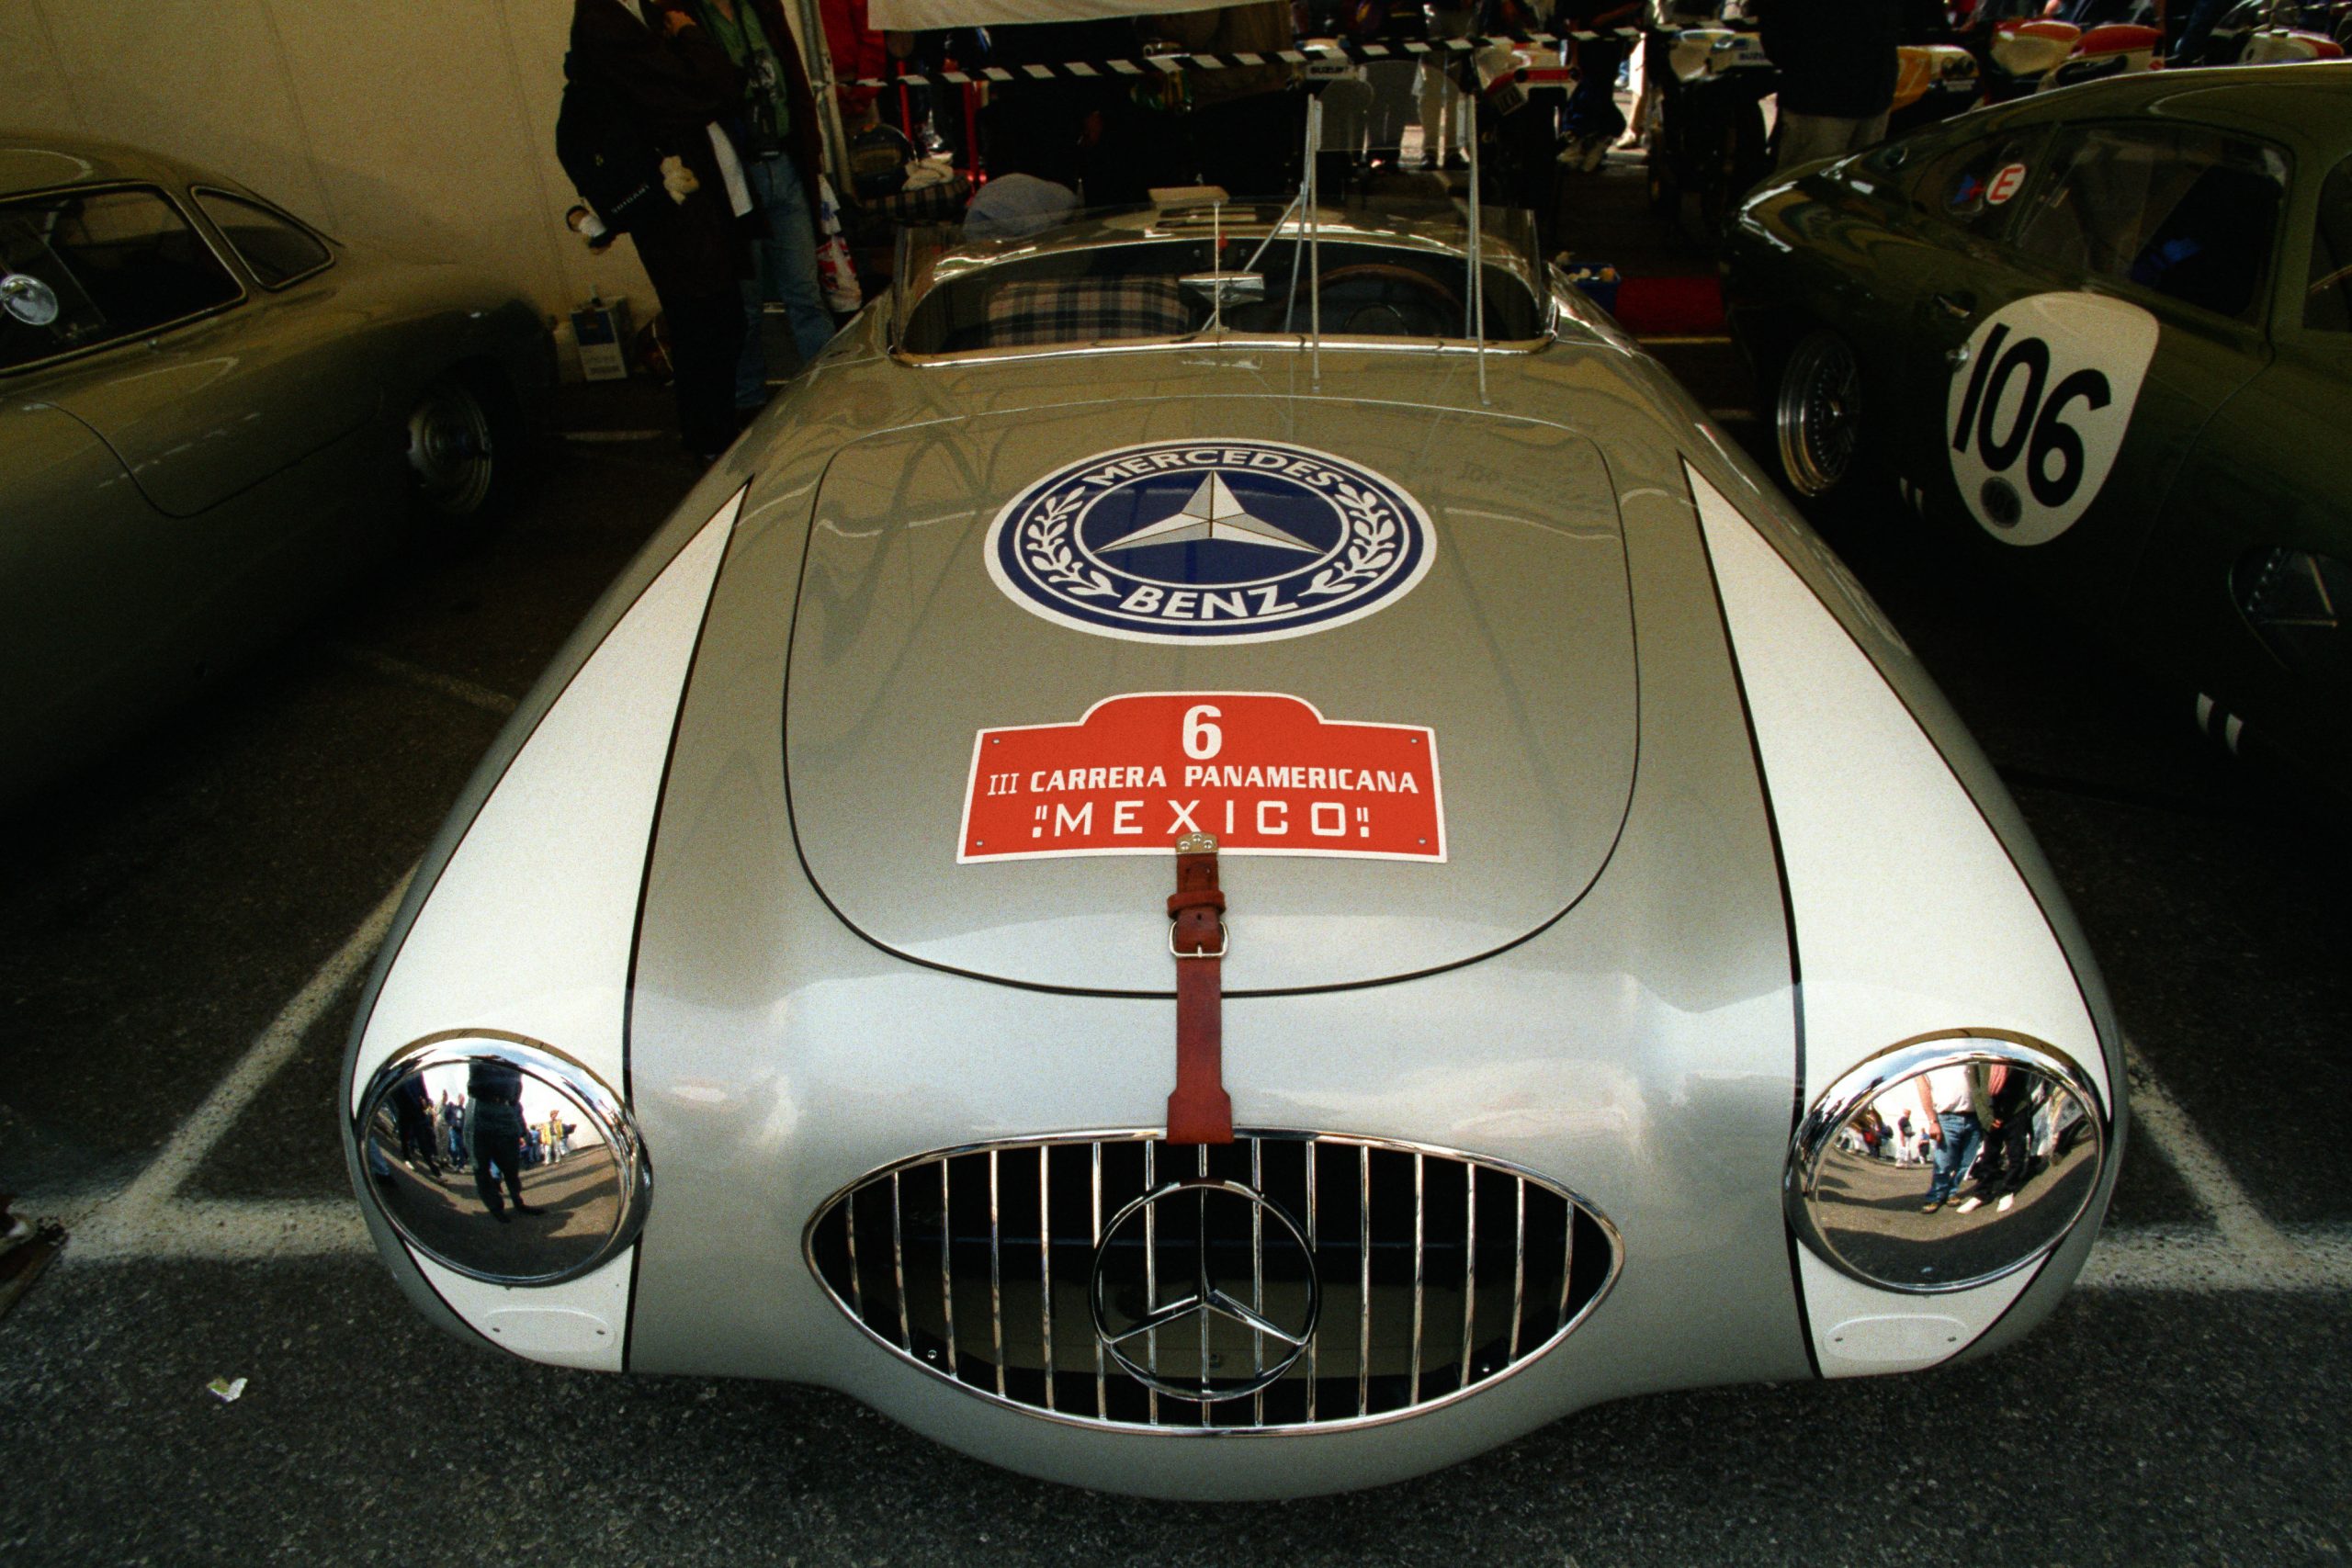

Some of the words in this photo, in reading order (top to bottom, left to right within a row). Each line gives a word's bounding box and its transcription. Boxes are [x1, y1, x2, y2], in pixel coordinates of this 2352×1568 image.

[1990, 167, 2023, 200] E
[1952, 322, 2110, 507] 106
[1081, 448, 1346, 488] MERCEDES
[1119, 585, 1299, 619] BENZ
[1182, 705, 1222, 761] 6
[987, 773, 1018, 795] III
[1030, 766, 1167, 792] CARRERA
[1184, 765, 1419, 794] PANAMERICANA
